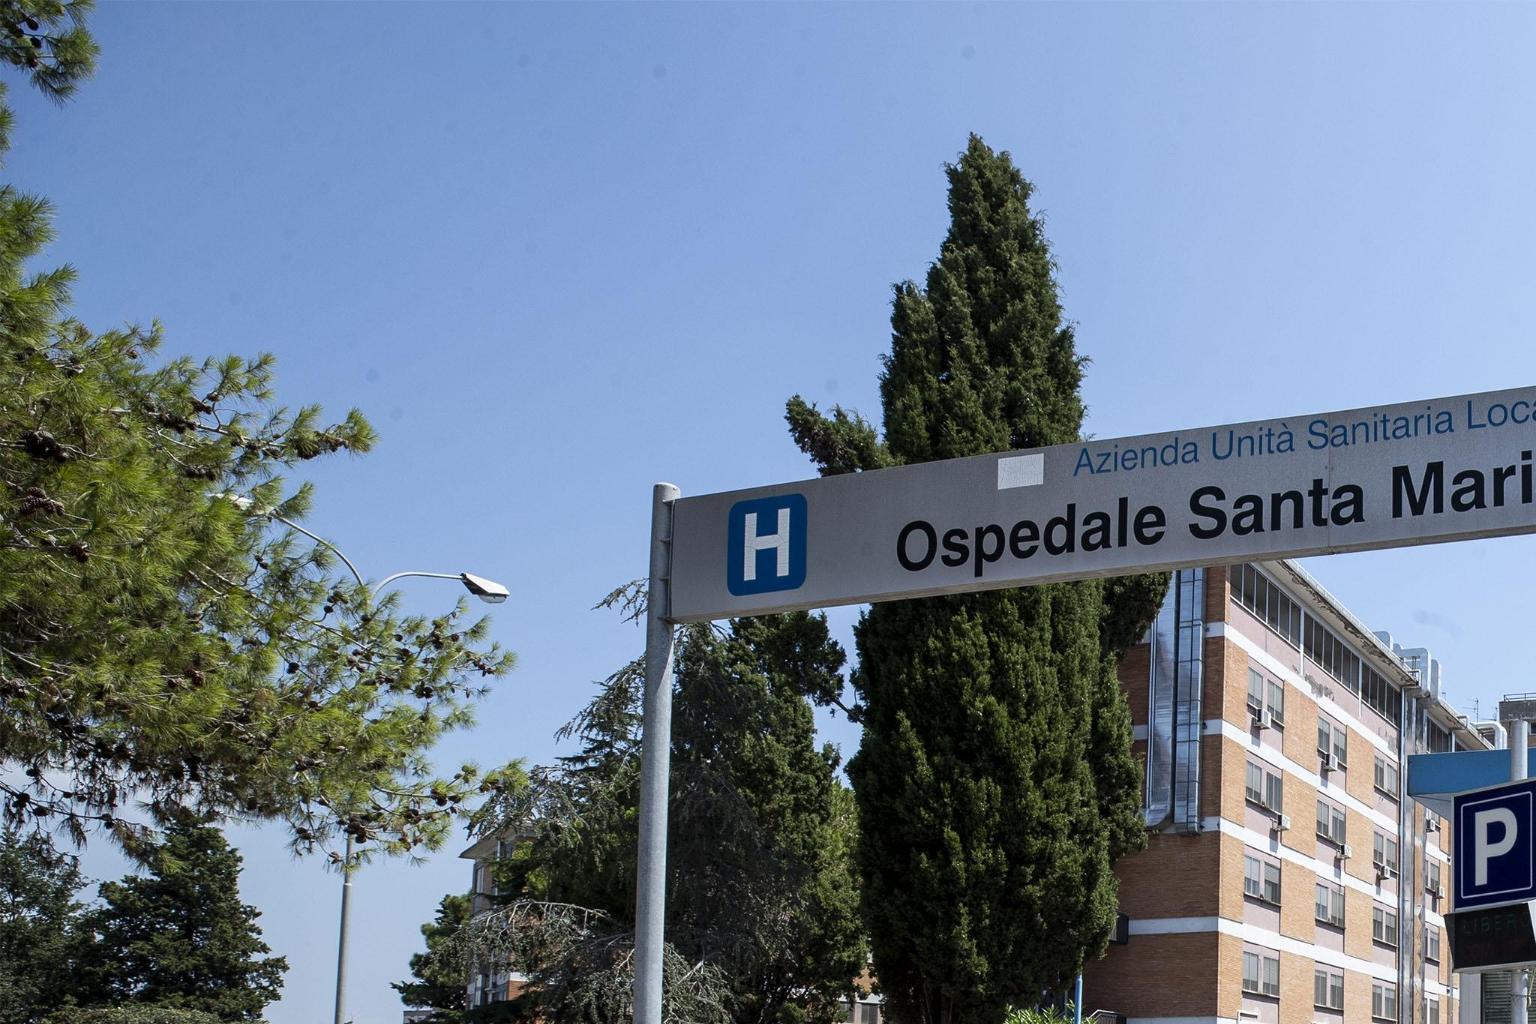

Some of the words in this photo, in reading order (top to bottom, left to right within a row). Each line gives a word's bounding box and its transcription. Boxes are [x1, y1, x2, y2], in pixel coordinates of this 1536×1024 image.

[1073, 436, 1200, 477] Azienda
[1211, 420, 1296, 460] Unità
[1307, 410, 1455, 450] Sanitaria
[742, 506, 791, 583] H
[896, 496, 1167, 579] Ospedale
[1188, 478, 1366, 540] Santa
[1474, 807, 1518, 887] P
